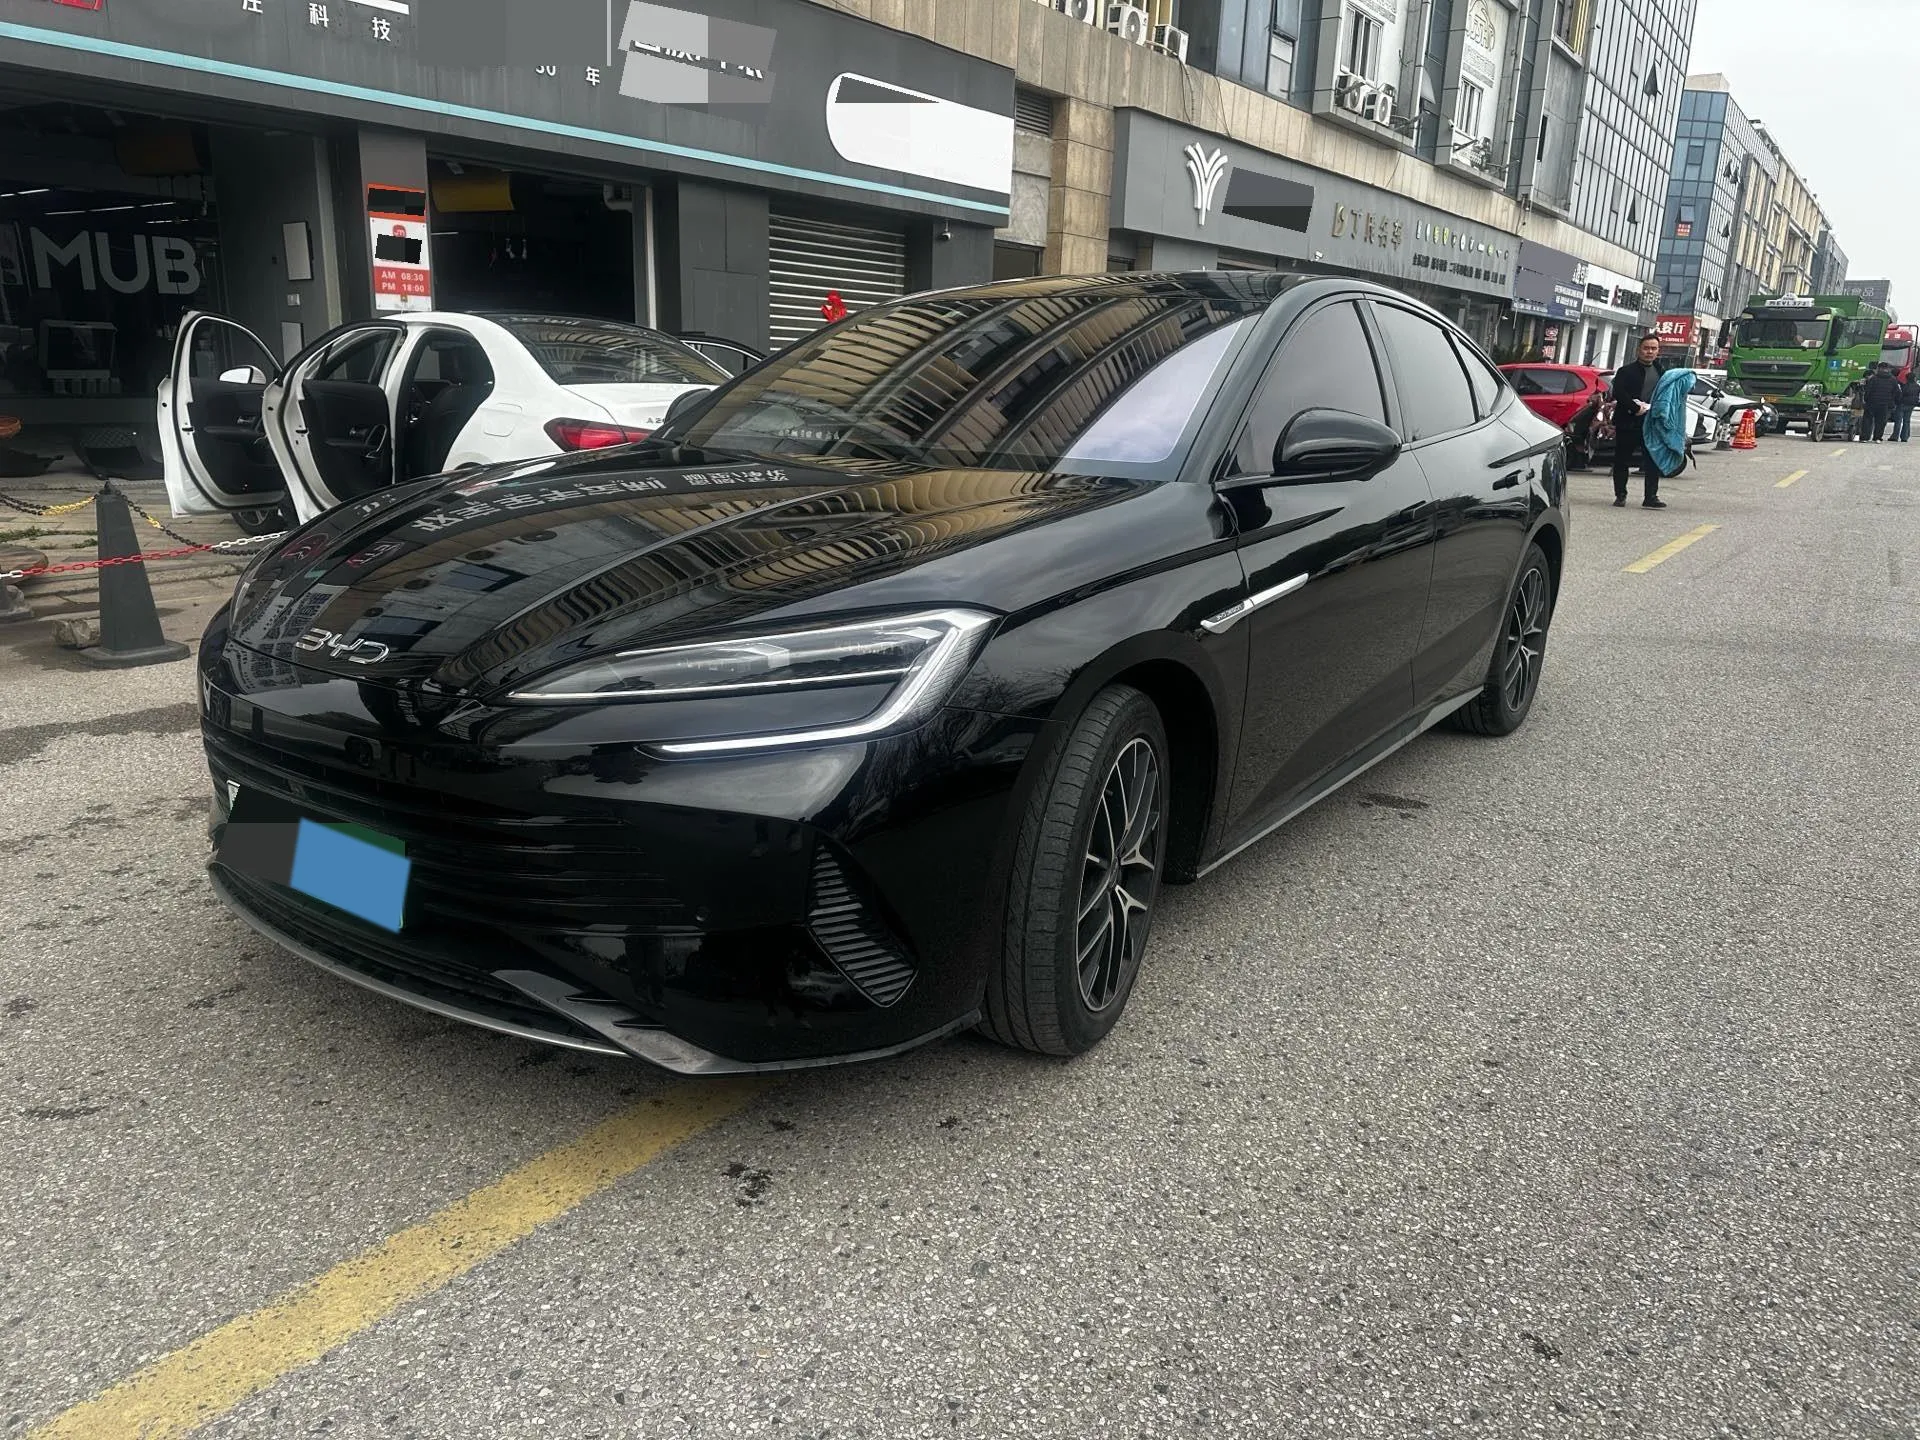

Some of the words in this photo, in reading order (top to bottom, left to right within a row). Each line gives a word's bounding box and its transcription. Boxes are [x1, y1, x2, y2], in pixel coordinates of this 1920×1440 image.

[585, 65, 600, 86] 年
[29, 226, 201, 295] MUB
[381, 270, 396, 279] AM
[401, 273, 424, 282] 08:30
[381, 282, 396, 291] PM
[401, 284, 425, 293] 18:00
[295, 627, 390, 665] BYD
